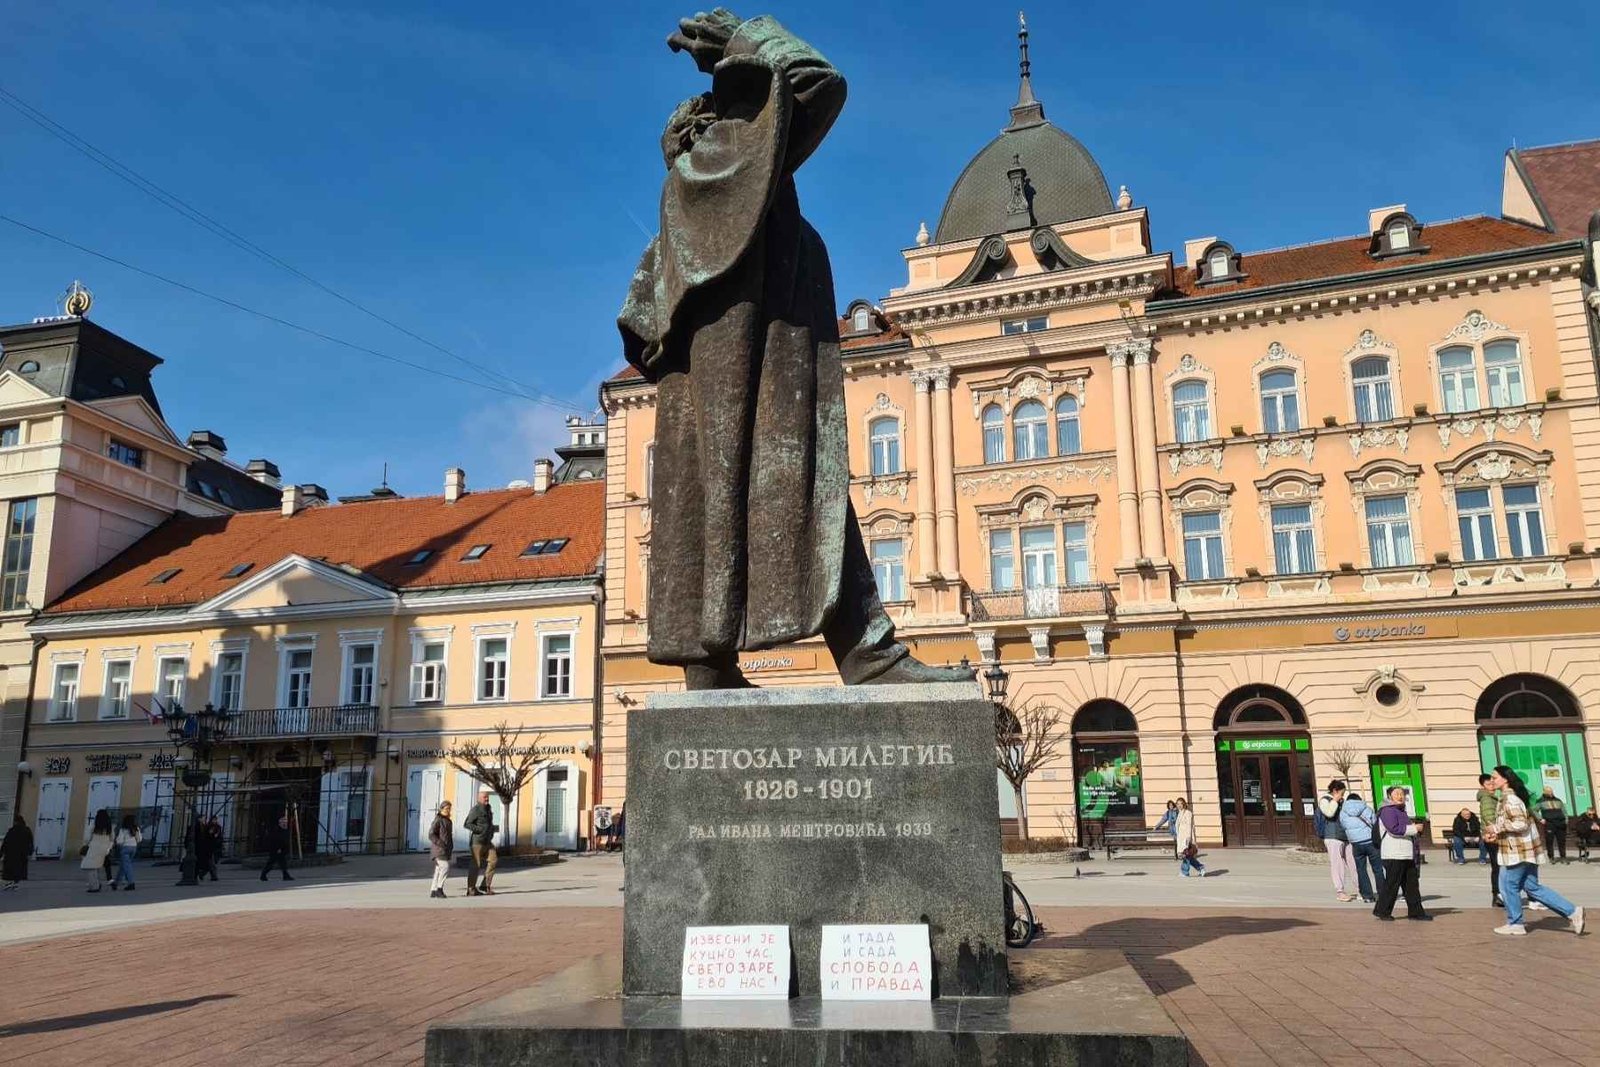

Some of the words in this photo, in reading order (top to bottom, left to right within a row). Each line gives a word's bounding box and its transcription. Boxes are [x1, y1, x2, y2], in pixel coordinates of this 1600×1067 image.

[1355, 622, 1426, 641] otpbanka
[743, 656, 793, 671] otpbanka
[663, 749, 803, 769] СВЕТОЗАР
[815, 744, 955, 767] МИЛЕТИЋ
[720, 823, 771, 839] ИВАНА
[779, 822, 887, 838] МЕШТРОВИЋА
[895, 821, 932, 837] 1939
[690, 934, 751, 946] ИЗВЕСНИ
[842, 933, 851, 944] И
[858, 931, 896, 943] ТАДА
[843, 947, 851, 957] И
[858, 946, 897, 957] САДА
[687, 962, 774, 976] СВЕТОЗАРЕ
[830, 961, 920, 974] СЛОБОДА
[697, 976, 726, 989] ЕВО
[852, 977, 923, 991] ПРАВДА
